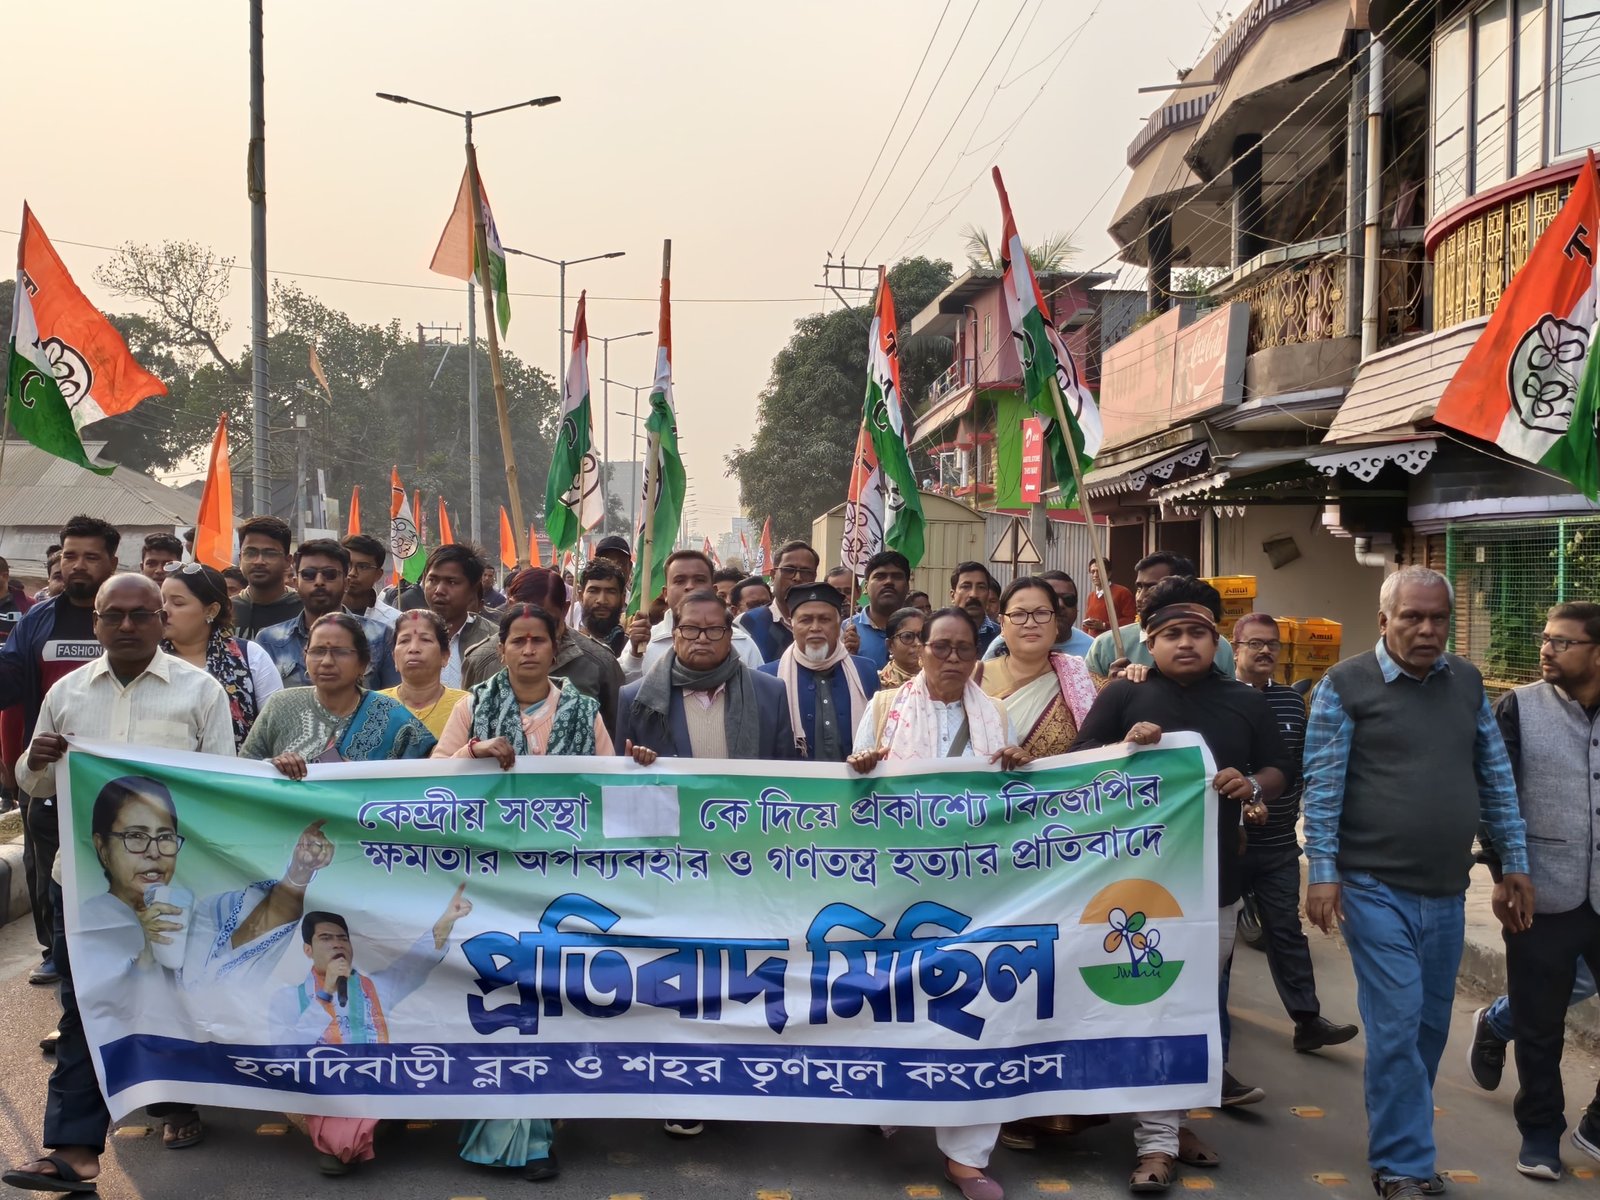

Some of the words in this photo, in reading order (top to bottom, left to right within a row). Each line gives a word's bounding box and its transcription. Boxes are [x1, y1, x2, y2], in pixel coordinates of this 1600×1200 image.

[57, 645, 103, 656] FASHION
[1309, 632, 1333, 640] Amul
[359, 787, 488, 834] কেন্দ্রীয়
[496, 792, 591, 839] সংস্থা
[700, 798, 749, 833] কে
[757, 786, 839, 834] দিয়ে
[851, 788, 987, 830] প্রকাশ্যে
[997, 769, 1163, 823] বিজেপির
[360, 840, 499, 877] ক্ষমতার
[512, 844, 711, 883] অপব্যবহার
[722, 848, 752, 877] ও
[766, 841, 878, 888] গণতন্ত্র
[888, 841, 998, 886] হত্যার
[1012, 823, 1166, 872] প্রতিবাদে
[461, 893, 789, 1035] প্রতিবাদ
[805, 900, 1059, 1040] মিছিল
[227, 1046, 456, 1088] হলদিবাড়ী
[467, 1055, 552, 1088] ব্লক
[566, 1056, 602, 1080] ও
[617, 1052, 725, 1086] শহর
[738, 1054, 884, 1095] তৃণমূল
[900, 1053, 1067, 1091] কংগ্রেস
